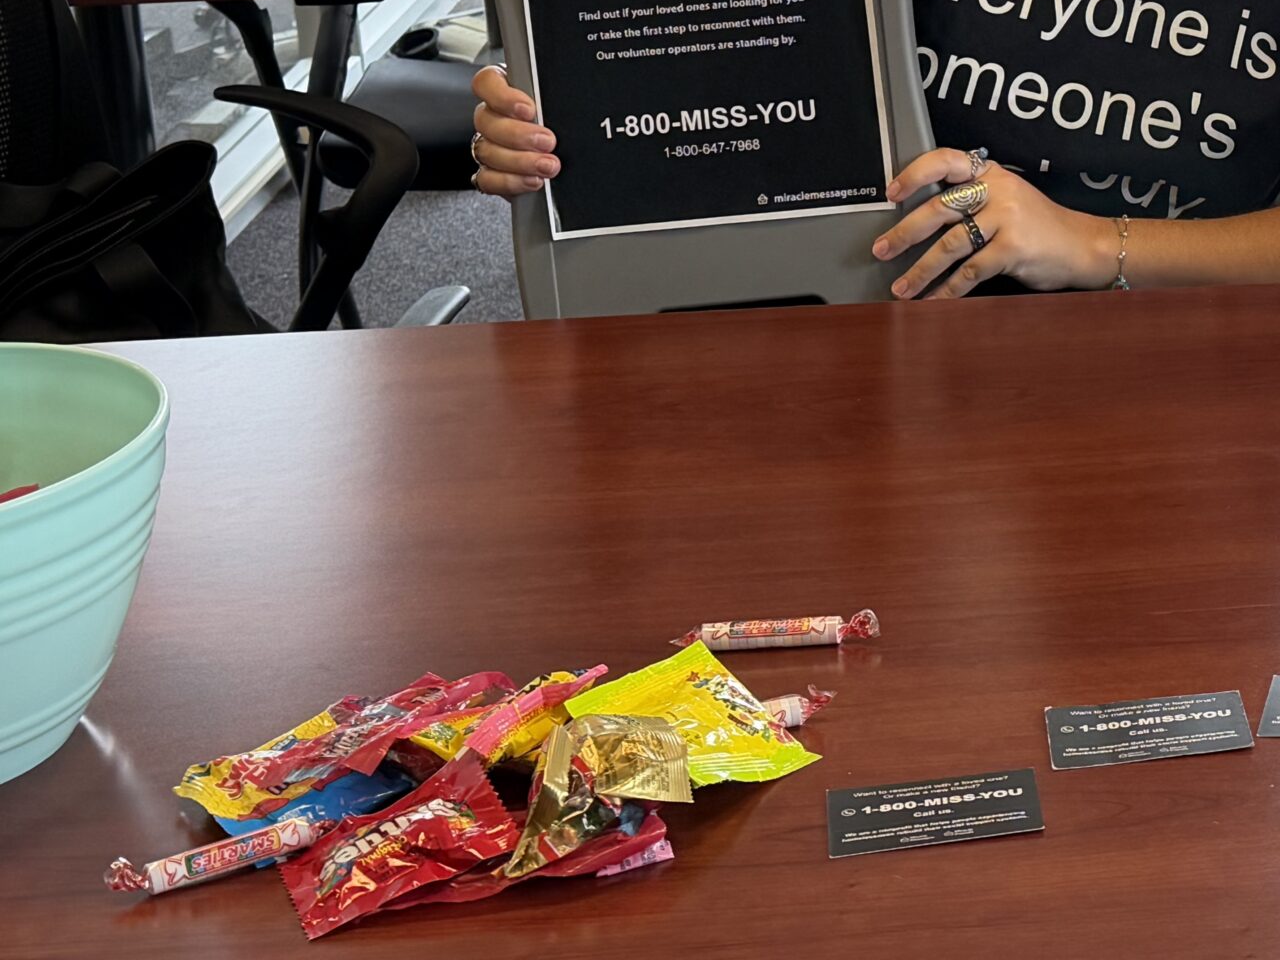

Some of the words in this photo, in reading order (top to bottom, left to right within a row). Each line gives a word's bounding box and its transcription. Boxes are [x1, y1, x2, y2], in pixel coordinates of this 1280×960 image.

[578, 10, 601, 21] Find
[602, 10, 620, 19] out
[622, 7, 629, 17] if
[630, 7, 654, 19] your
[655, 2, 684, 14] loved
[685, 2, 710, 12] ones
[711, 1, 728, 10] are
[587, 33, 598, 41] or
[599, 29, 622, 40] take
[623, 28, 641, 38] the
[642, 25, 662, 36] first
[664, 25, 686, 35] step
[687, 23, 699, 32] to
[700, 18, 750, 31] reconnect
[751, 15, 774, 26] with
[776, 14, 806, 24] them.
[596, 50, 615, 60] Our
[617, 47, 666, 58] volunteer
[667, 43, 716, 55] operators
[717, 41, 734, 50] are
[735, 36, 779, 48] standing
[780, 34, 796, 46] by.
[1230, 9, 1278, 80] is
[915, 46, 1238, 160] omeone's
[600, 98, 817, 139] 1-800-MISS-YOU
[664, 138, 760, 159] 1-800-647-7968
[773, 184, 877, 204] miraclemessages.org
[1079, 709, 1231, 733] 1-800-MISS-YOU
[1128, 728, 1150, 736] Call
[861, 788, 1023, 815] 1-800-MISS-YOU
[913, 809, 935, 817] Call
[191, 835, 278, 869] SMARTIES
